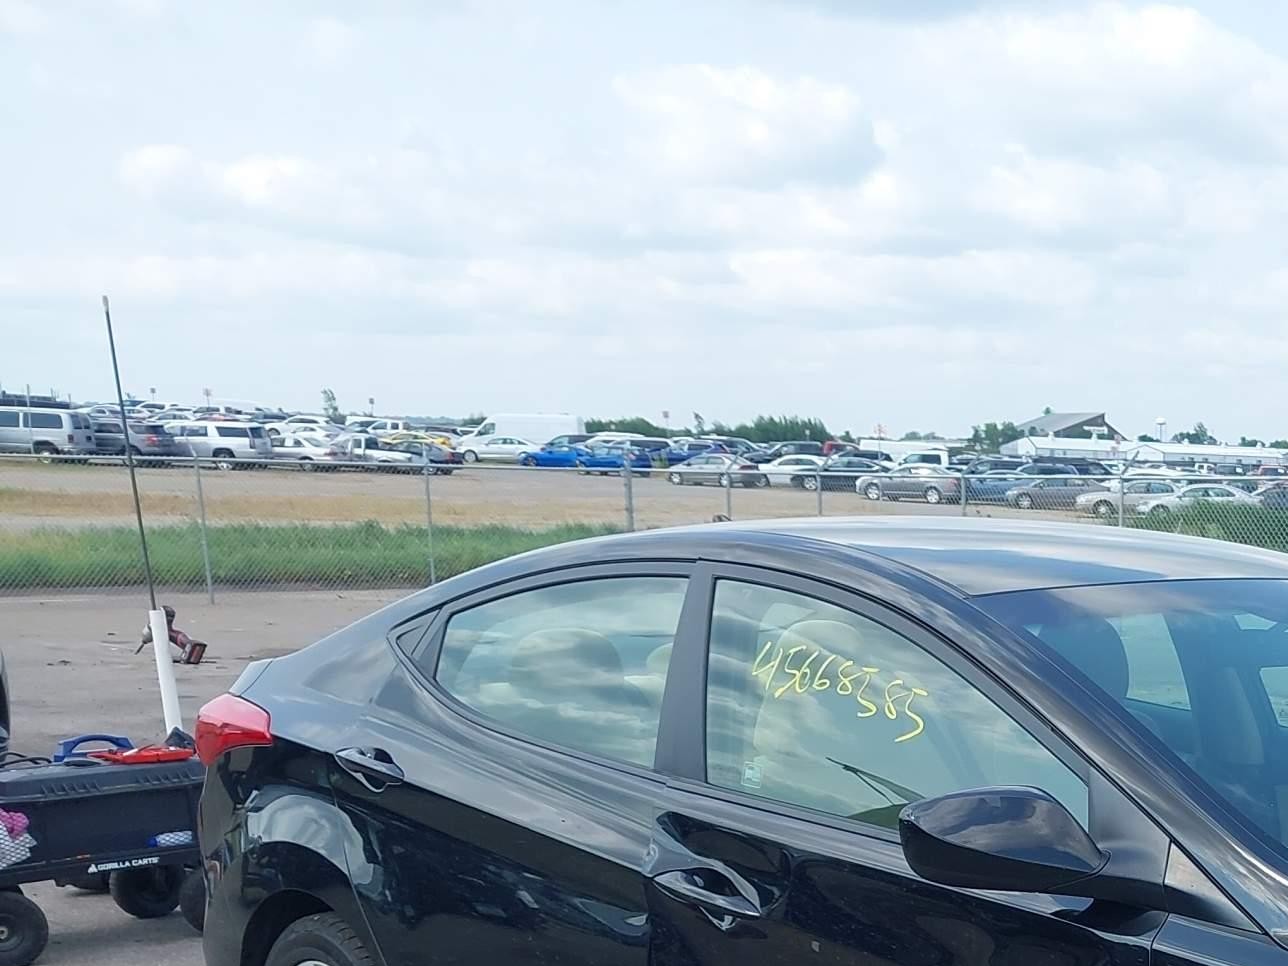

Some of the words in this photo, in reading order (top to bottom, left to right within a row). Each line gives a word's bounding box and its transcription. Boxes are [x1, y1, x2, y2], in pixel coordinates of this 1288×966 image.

[751, 641, 929, 743] 45668585
[97, 861, 131, 872] GORILLA
[131, 857, 158, 867] CARTS
